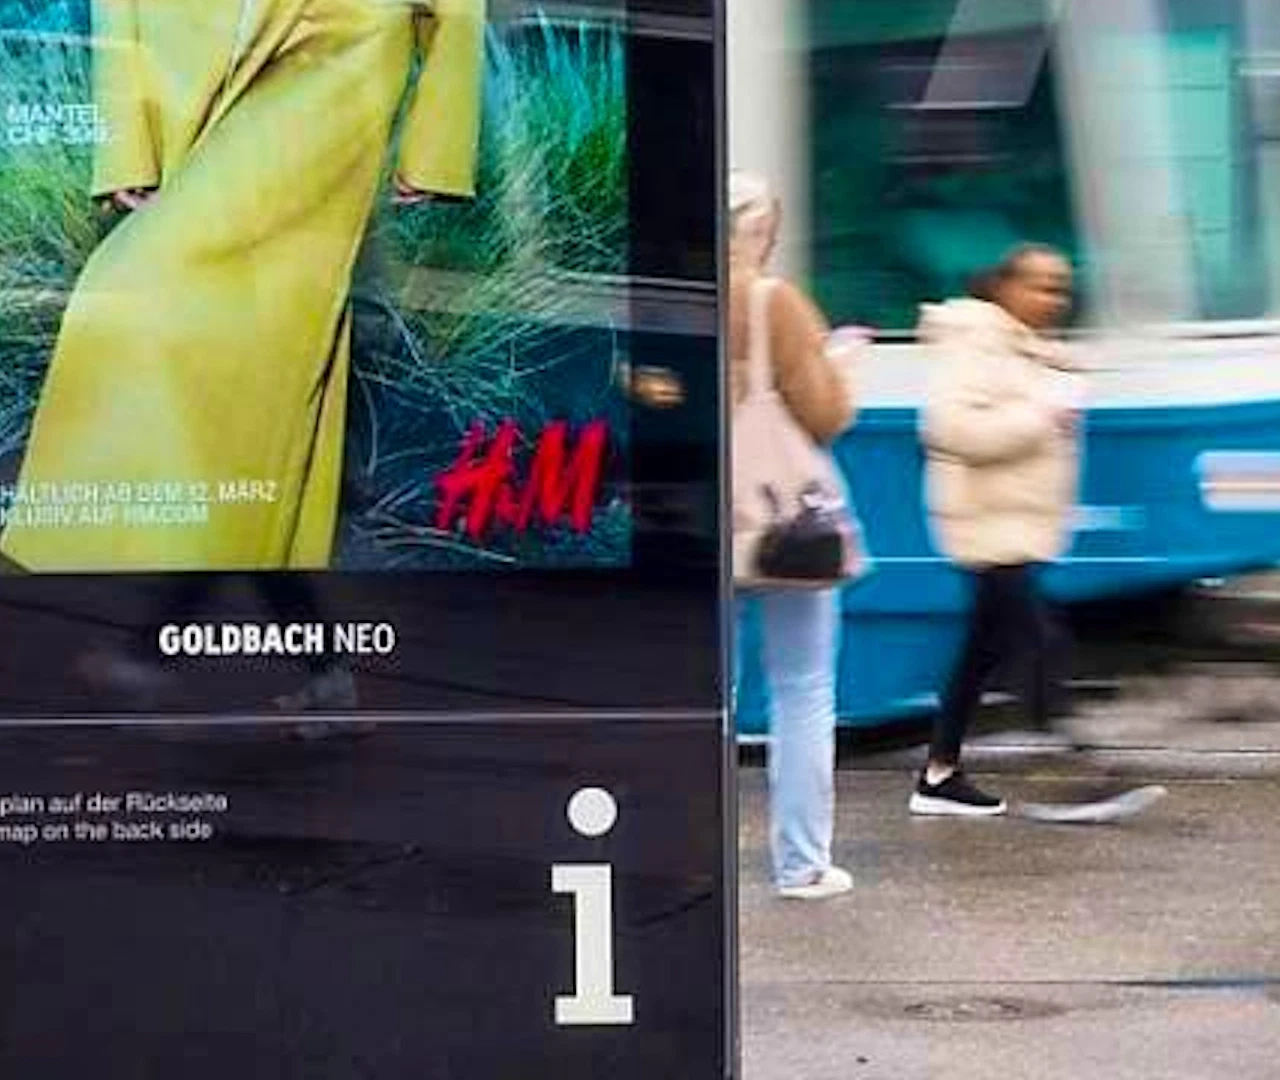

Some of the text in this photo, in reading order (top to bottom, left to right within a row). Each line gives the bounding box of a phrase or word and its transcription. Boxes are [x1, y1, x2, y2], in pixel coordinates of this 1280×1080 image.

[7, 104, 106, 123] MANTEL
[219, 478, 277, 502] MÄRZ
[159, 622, 396, 655] GOLDBACH NEO
[48, 791, 82, 813] auf
[86, 791, 120, 812] der
[126, 790, 228, 812] Rückseite
[42, 823, 68, 841] on
[74, 820, 108, 841] the
[112, 819, 164, 841] back
[170, 819, 213, 840] side
